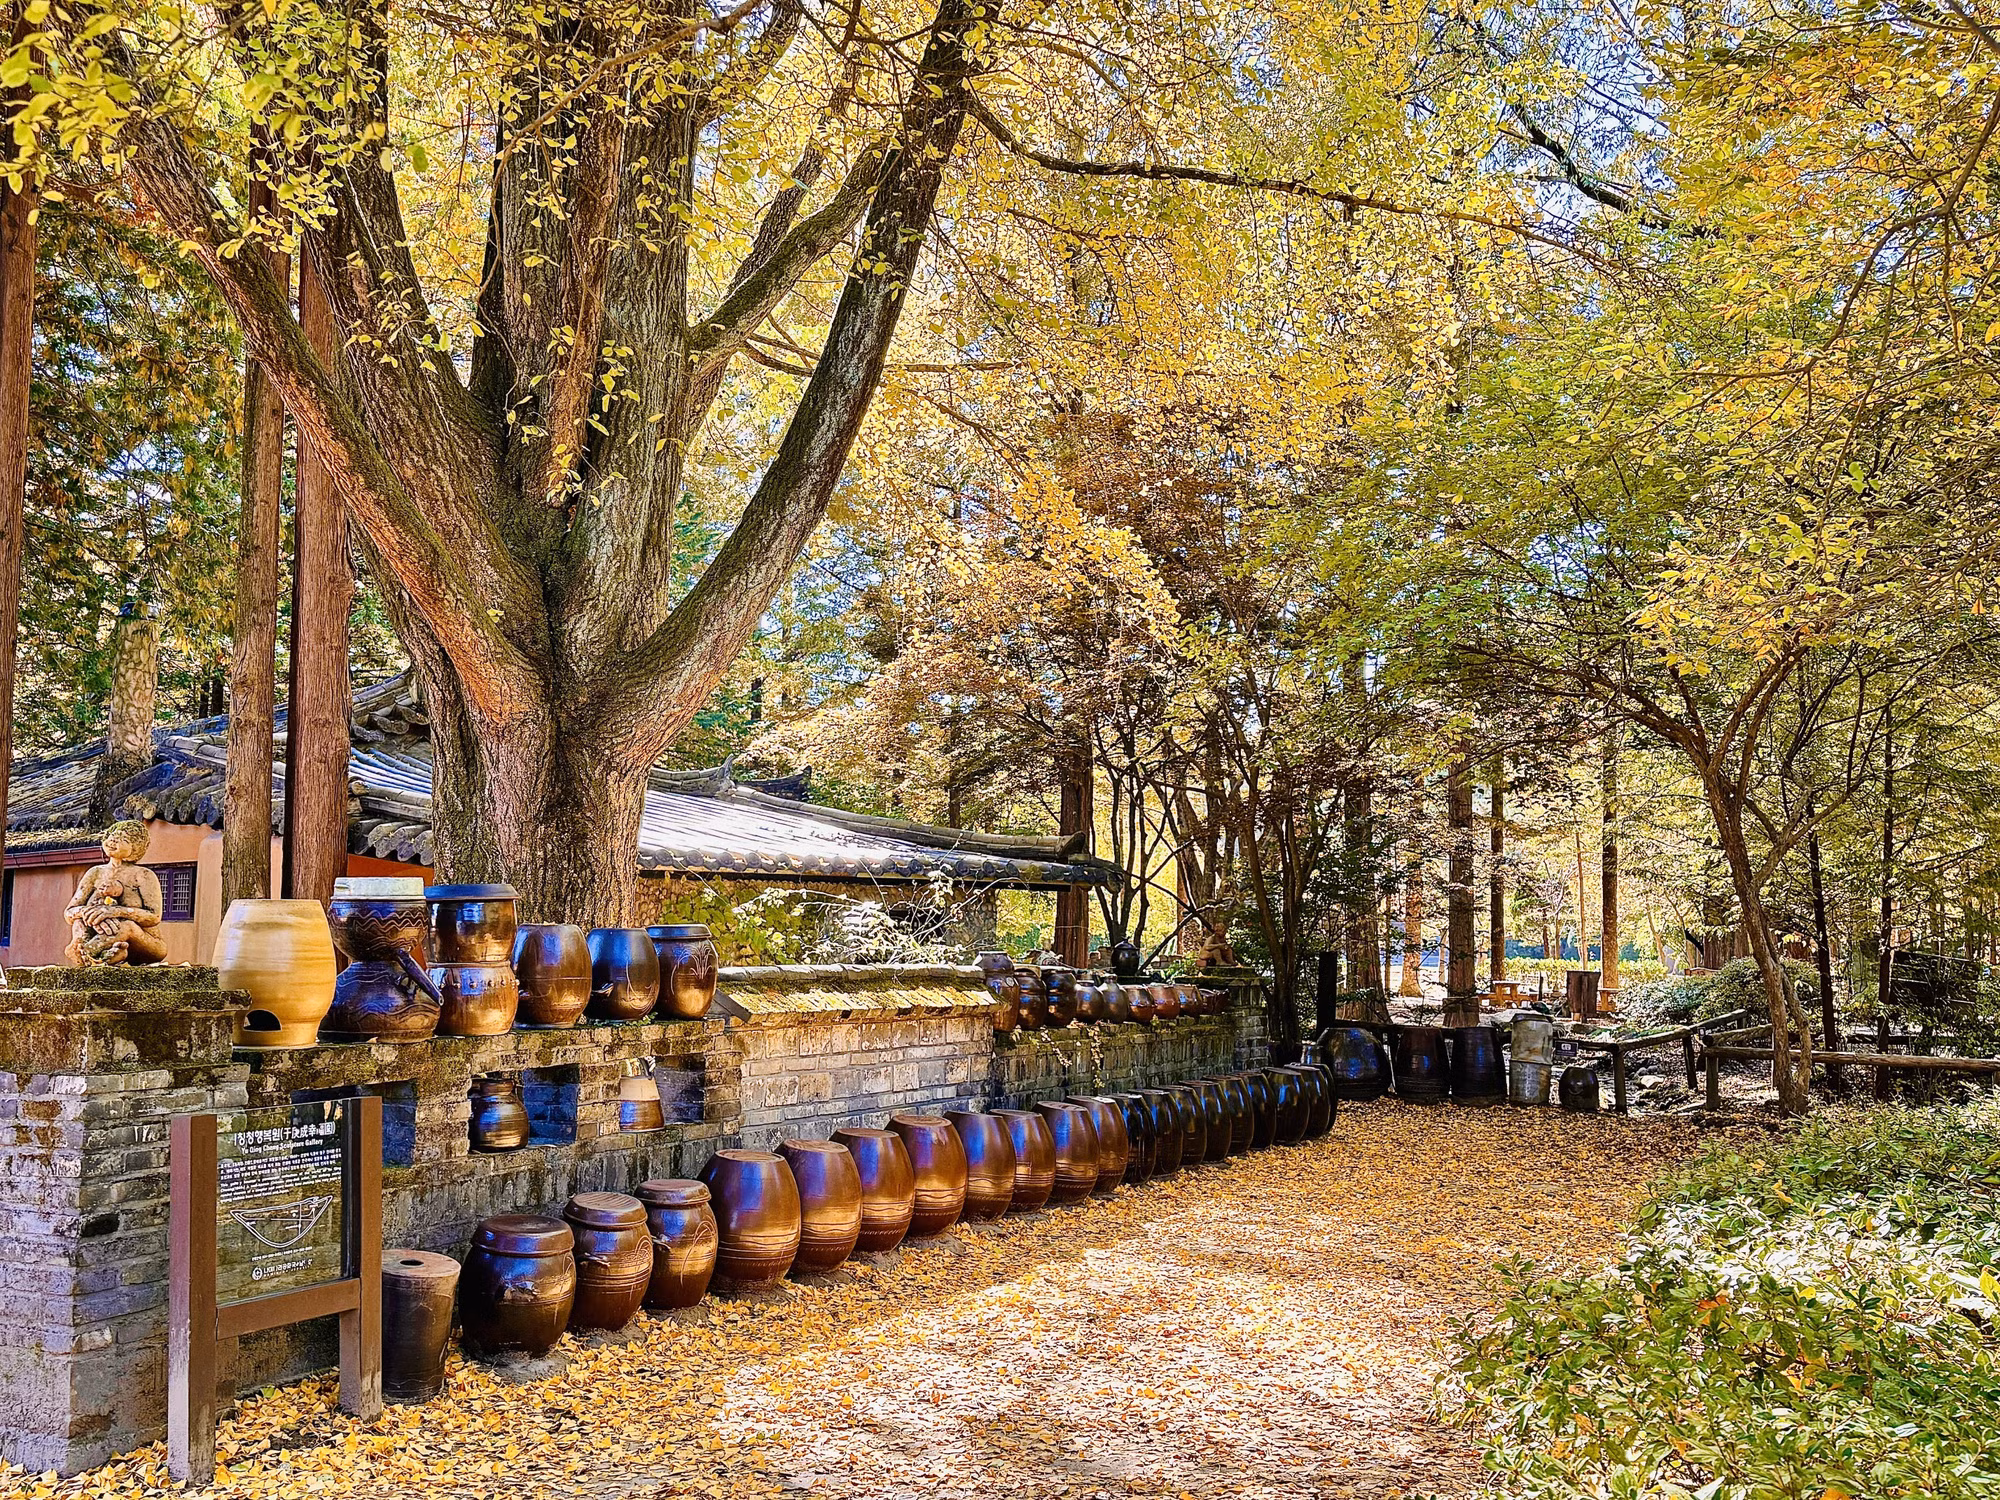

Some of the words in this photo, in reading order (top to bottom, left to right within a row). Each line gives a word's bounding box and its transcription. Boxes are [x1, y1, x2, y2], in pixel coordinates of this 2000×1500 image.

[250, 1145, 262, 1154] Qing
[280, 1140, 304, 1150] Sculpture
[305, 1139, 323, 1147] Gallery
